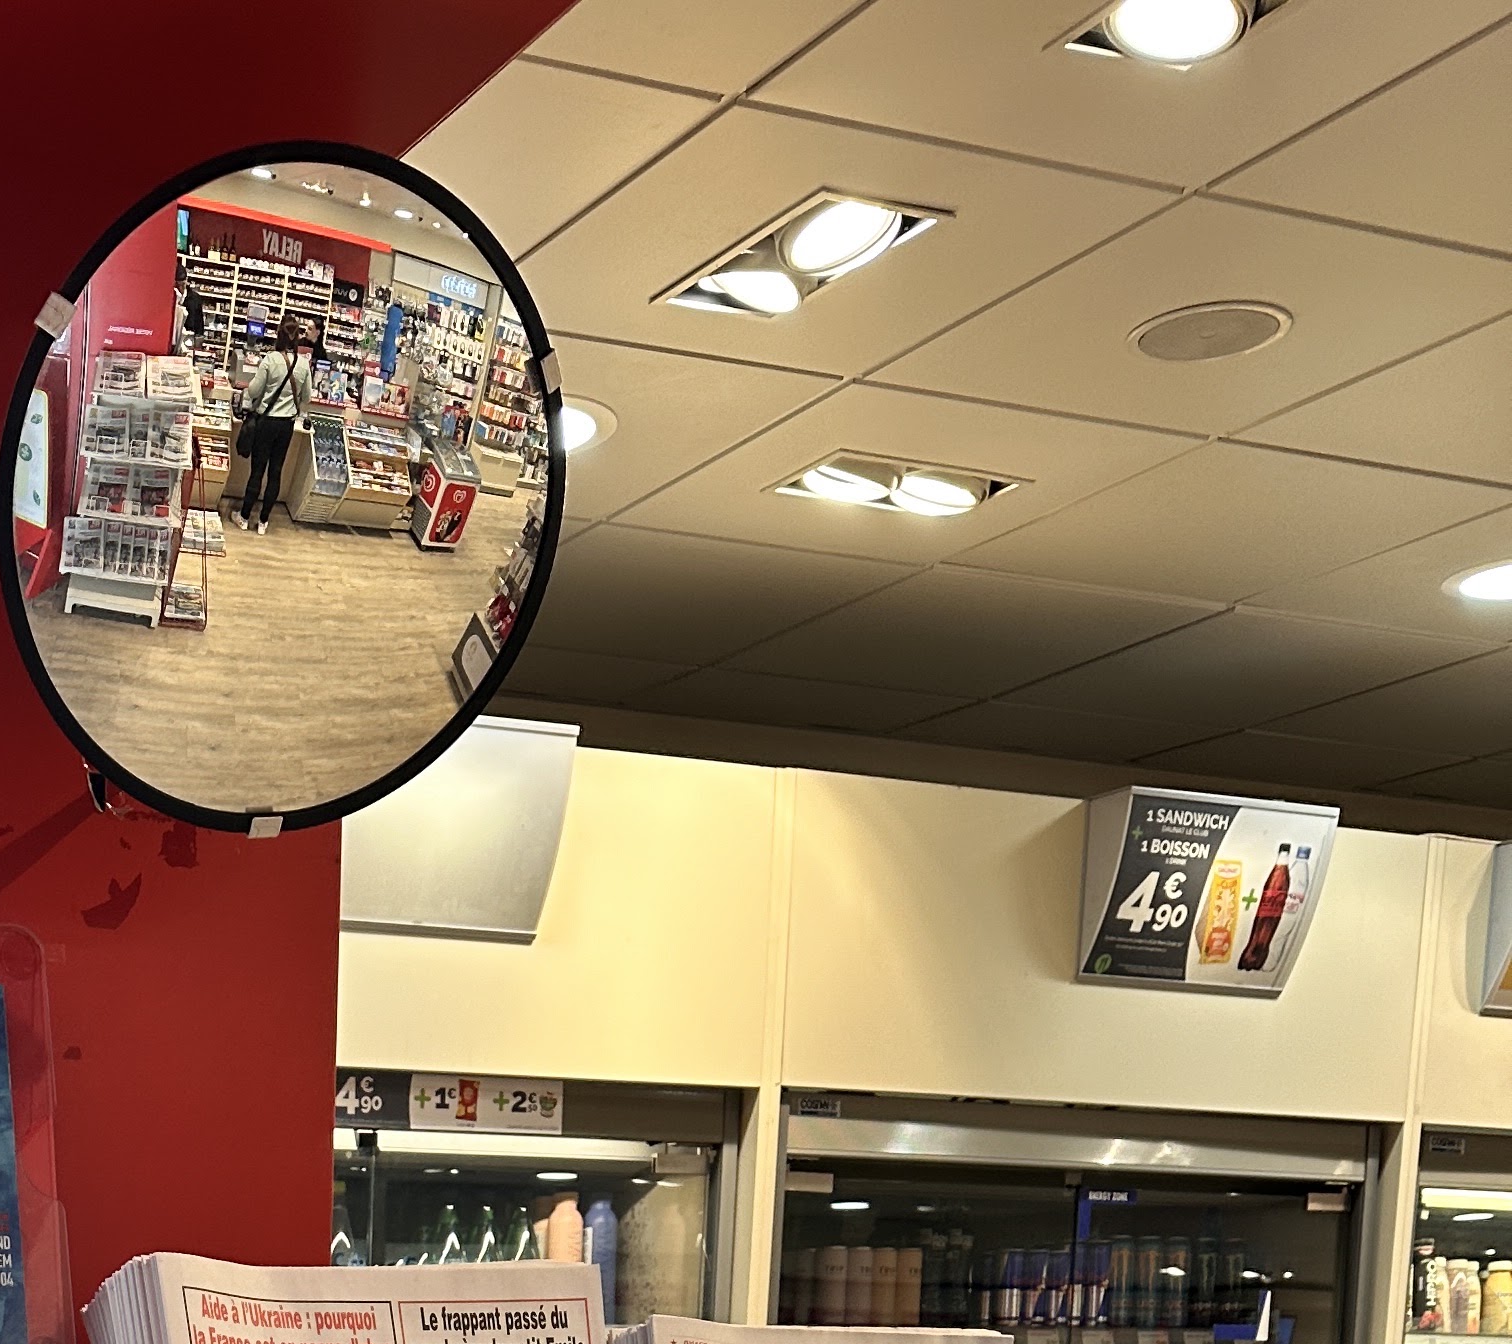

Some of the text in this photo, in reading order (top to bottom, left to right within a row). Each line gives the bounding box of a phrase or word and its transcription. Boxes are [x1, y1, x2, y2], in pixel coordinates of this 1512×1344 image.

[1147, 808, 1230, 830] 1 SANDWICH
[1141, 839, 1210, 859] 1 BOISSON
[201, 1293, 377, 1336] Aide à l'Ukraine pourquoi
